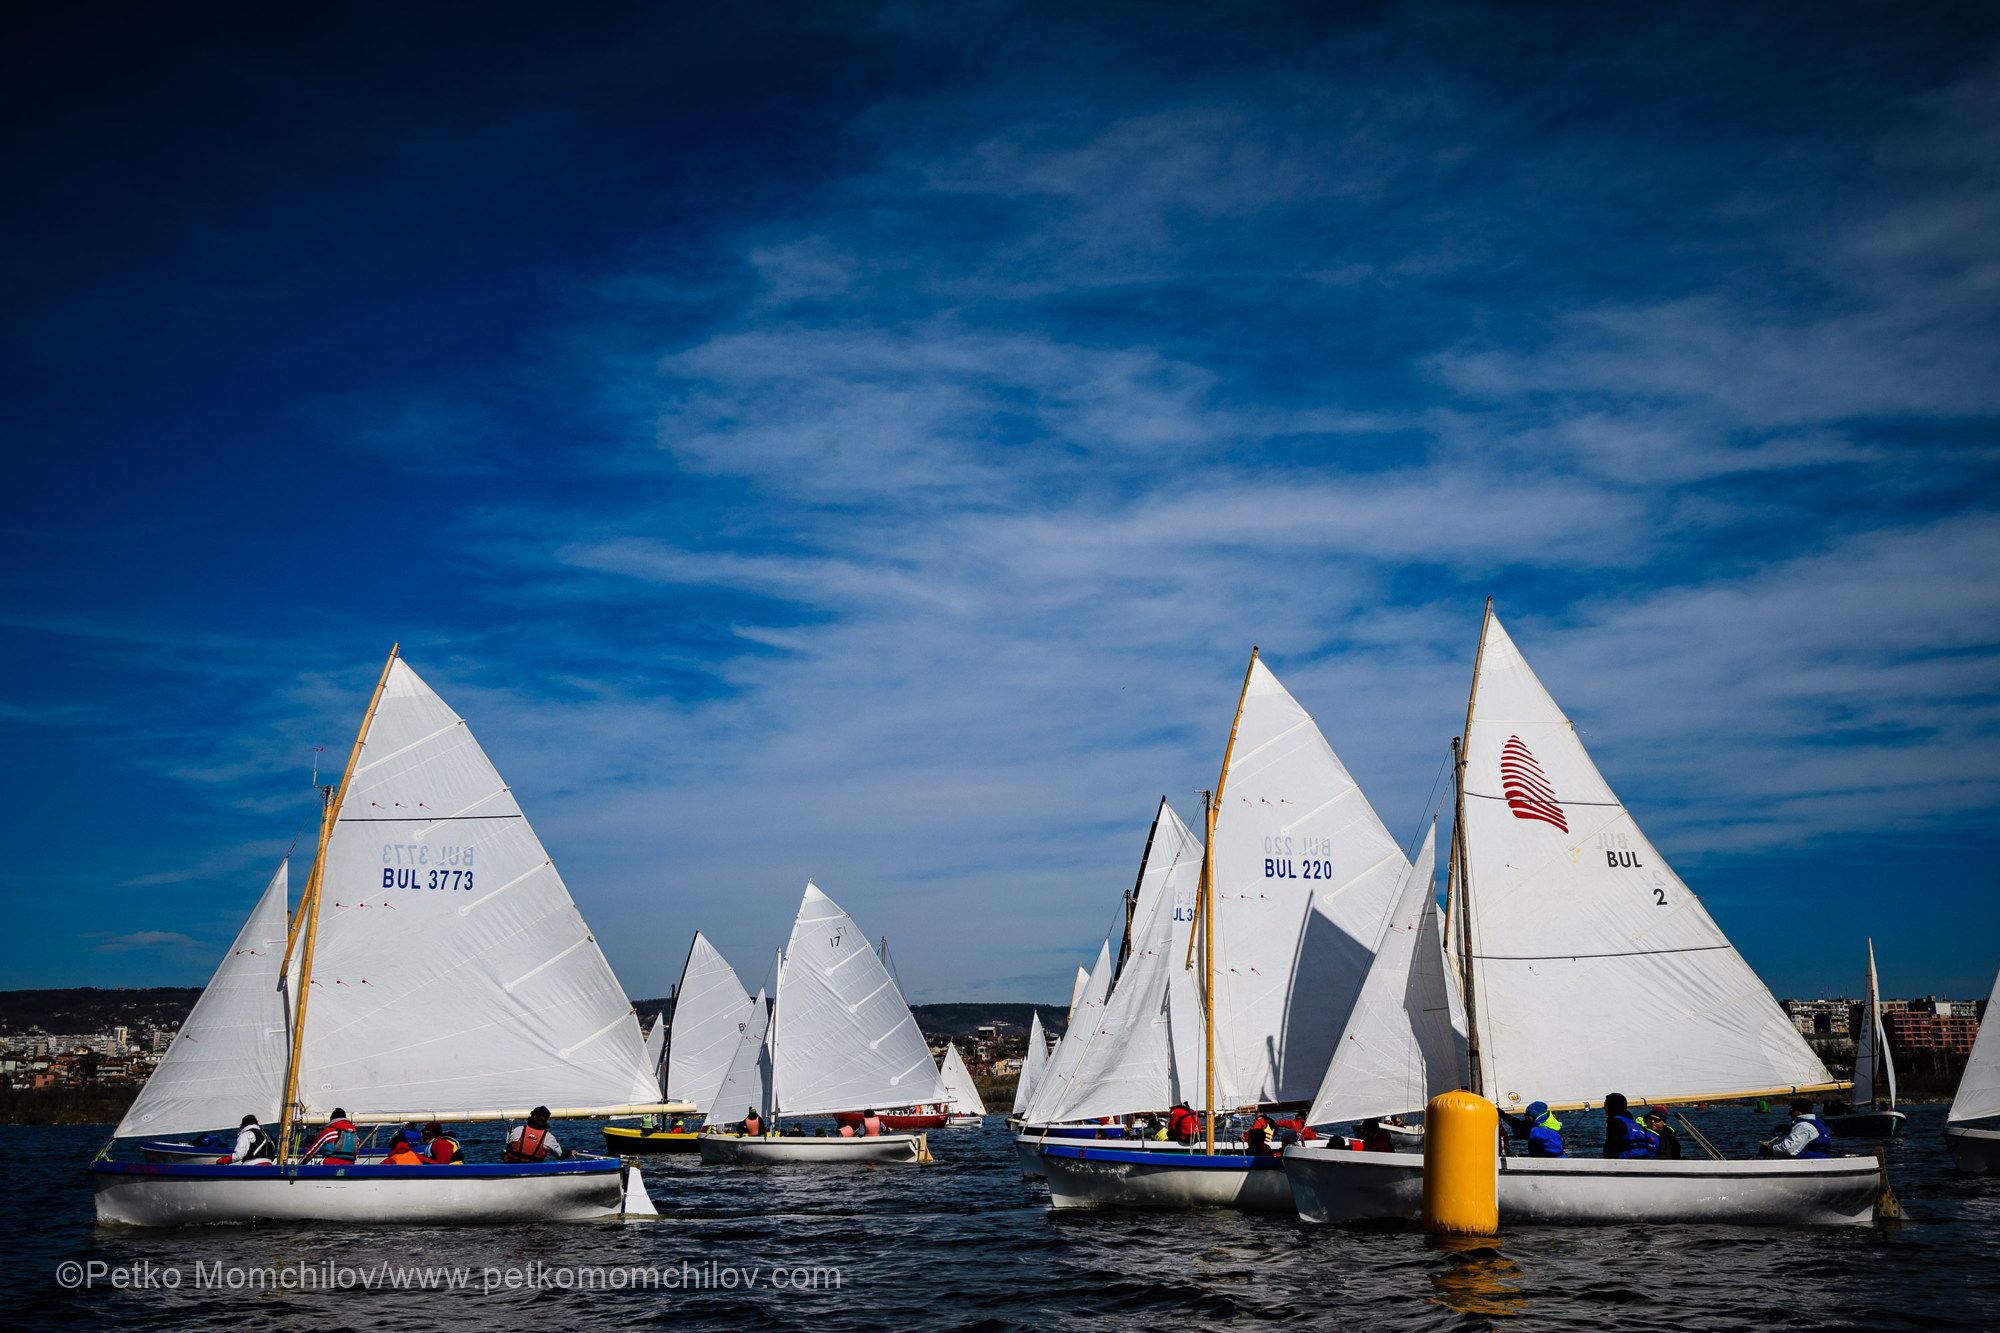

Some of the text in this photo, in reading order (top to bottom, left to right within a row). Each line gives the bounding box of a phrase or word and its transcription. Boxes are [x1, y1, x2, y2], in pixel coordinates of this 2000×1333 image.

[1606, 850, 1643, 868] BUL
[1265, 858, 1332, 880] BUL 220
[382, 867, 474, 891] BUL 3773
[1653, 888, 1668, 906] 2
[829, 935, 841, 948] 17
